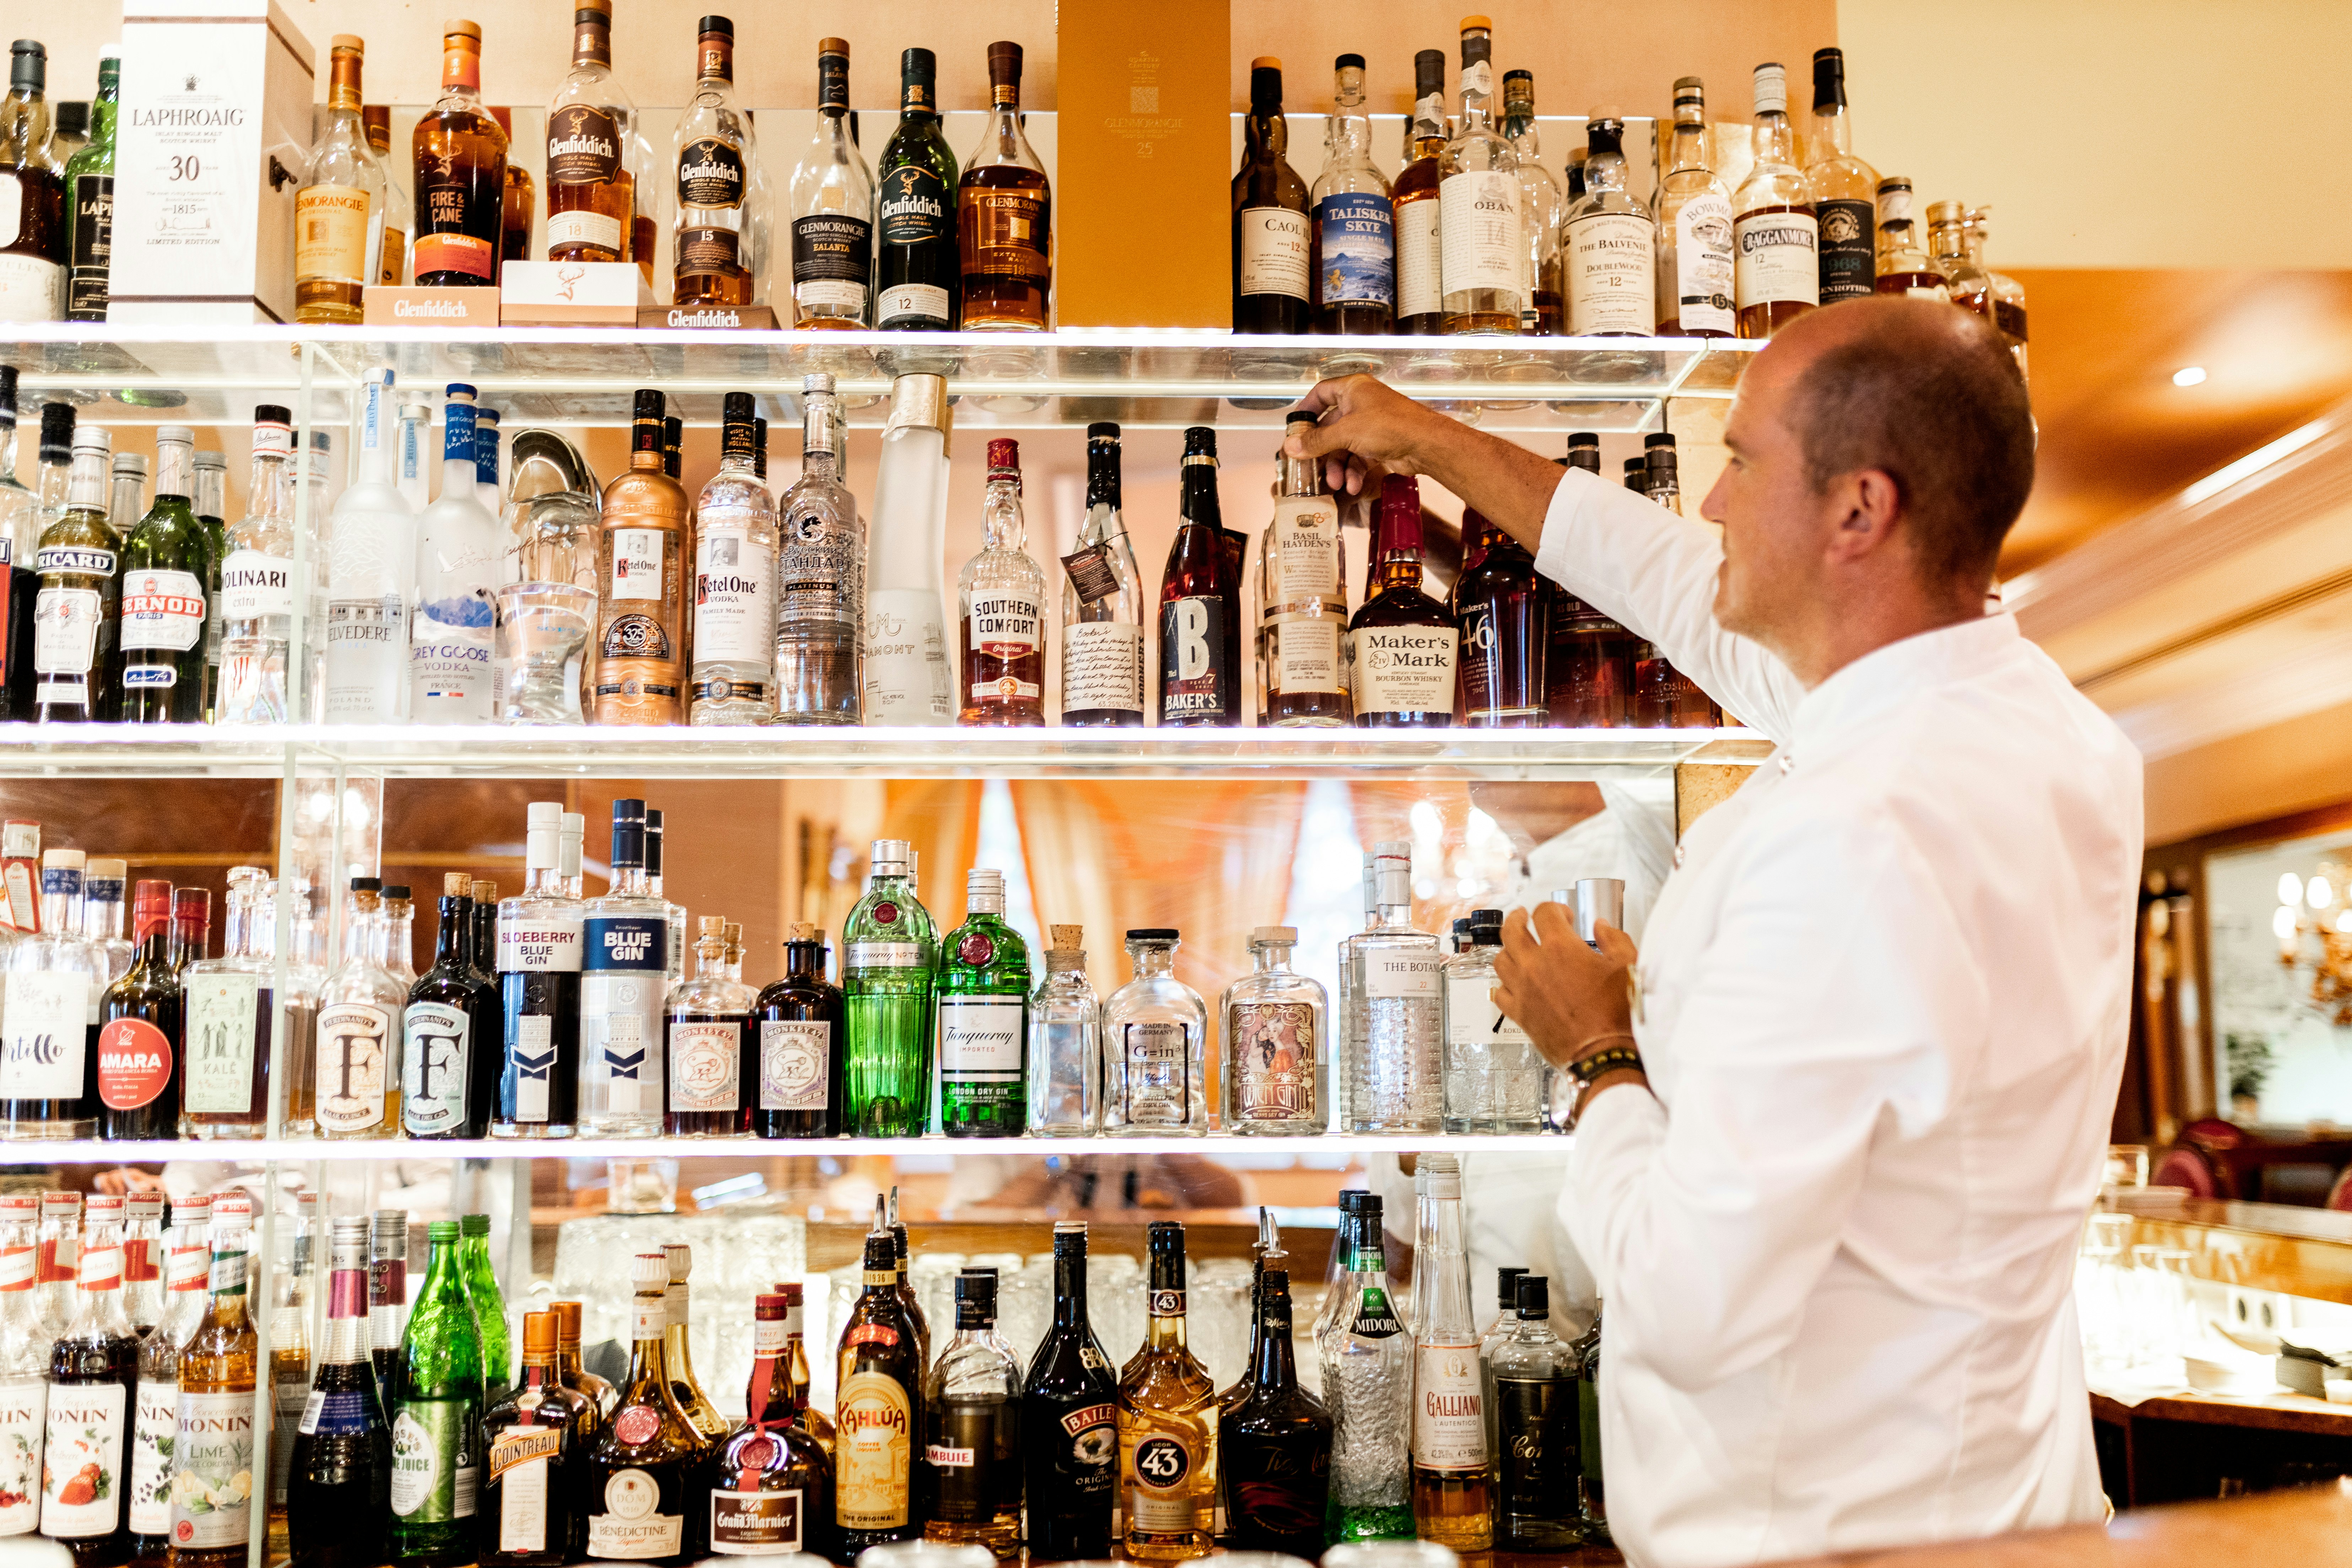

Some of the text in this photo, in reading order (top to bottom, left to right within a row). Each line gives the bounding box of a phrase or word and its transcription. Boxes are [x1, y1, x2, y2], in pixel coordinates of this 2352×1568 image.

[133, 109, 244, 126] LAPHROAIG
[549, 134, 615, 158] Glenfiddich
[1136, 142, 1153, 155] 25
[169, 155, 200, 181] 30
[681, 161, 741, 183] Glenfiddich
[430, 191, 465, 207] FIRE &
[172, 204, 196, 214] 1815
[881, 195, 942, 219] Glenfiddich
[1474, 200, 1514, 213] OBAN
[432, 209, 463, 223] CANE
[1329, 208, 1390, 225] TALISKER
[568, 225, 582, 236] 18
[799, 222, 865, 237] GLENMORANGIE
[1265, 218, 1301, 236] CAOL
[1345, 221, 1382, 233] SKYE
[442, 235, 477, 249] Glenfiddich
[701, 231, 714, 241] 15
[1742, 228, 1815, 256] CRAGGANMORE
[813, 243, 850, 253] EALANTA
[1291, 241, 1301, 253] 12
[1579, 239, 1647, 253] THE BALVENIE
[1755, 254, 1765, 263] 12
[1012, 264, 1025, 276] 18
[1609, 276, 1622, 286] 12
[899, 298, 911, 310] 12
[1714, 296, 1726, 306] 15
[394, 299, 467, 318] Glenfiddich
[667, 309, 741, 328] Glenfiddich
[1313, 512, 1325, 524] 8
[1282, 540, 1331, 548] HAYDEN'S
[37, 553, 109, 570] RICARD
[618, 559, 656, 576] Ketel One
[698, 576, 756, 601] Ketel One
[233, 596, 255, 607] extra
[975, 600, 1038, 619] SOUTHERN
[1459, 602, 1489, 616] Maker's
[623, 628, 645, 639] 325
[979, 618, 1034, 635] COMFORT
[1076, 626, 1111, 638] Booker's
[1177, 599, 1210, 681] B
[1367, 635, 1450, 649] Maker's
[1460, 614, 1495, 656] 46
[413, 645, 489, 663] GREY GOOSE
[993, 644, 1023, 653] Original
[424, 662, 470, 672] VODKA
[1391, 653, 1449, 667] Mark
[1206, 673, 1217, 684] 7
[1166, 693, 1217, 710] BAKER'S
[502, 932, 575, 943] SLOEBERRY
[604, 932, 651, 947] BLUE
[520, 946, 553, 955] BLUE
[611, 946, 644, 961] GIN
[850, 949, 924, 962] Tanqueray TEN
[525, 956, 547, 965] GIN
[1383, 962, 1407, 972] THE
[1418, 980, 1428, 989] 22
[676, 1027, 719, 1041] MONKEY
[765, 1026, 810, 1039] MONKEY
[946, 1026, 1014, 1045] Tanqueray
[100, 1053, 162, 1069] AMARA
[331, 1029, 385, 1100] F
[413, 1031, 464, 1100] F
[1243, 1085, 1298, 1110] WIEN GIN
[87, 1199, 117, 1207] MONIN
[177, 1197, 209, 1206] MONIN
[868, 1274, 886, 1284] 1936
[1159, 1295, 1176, 1309] 43
[1355, 1318, 1399, 1334] MIDORI
[1427, 1391, 1481, 1418] GALLIANO
[178, 1415, 250, 1434] MONIN
[837, 1400, 906, 1436] KAHLÚA
[190, 1444, 230, 1459] LIME
[493, 1431, 556, 1472] COINTREAU
[401, 1458, 429, 1471] JUICE
[1142, 1448, 1179, 1477] 43
[616, 1494, 646, 1503] DOM
[717, 1512, 793, 1529] Grand Marnier
[843, 1514, 895, 1523] THE ORIGINAL
[599, 1525, 667, 1537] BÉNÉDICTINE
